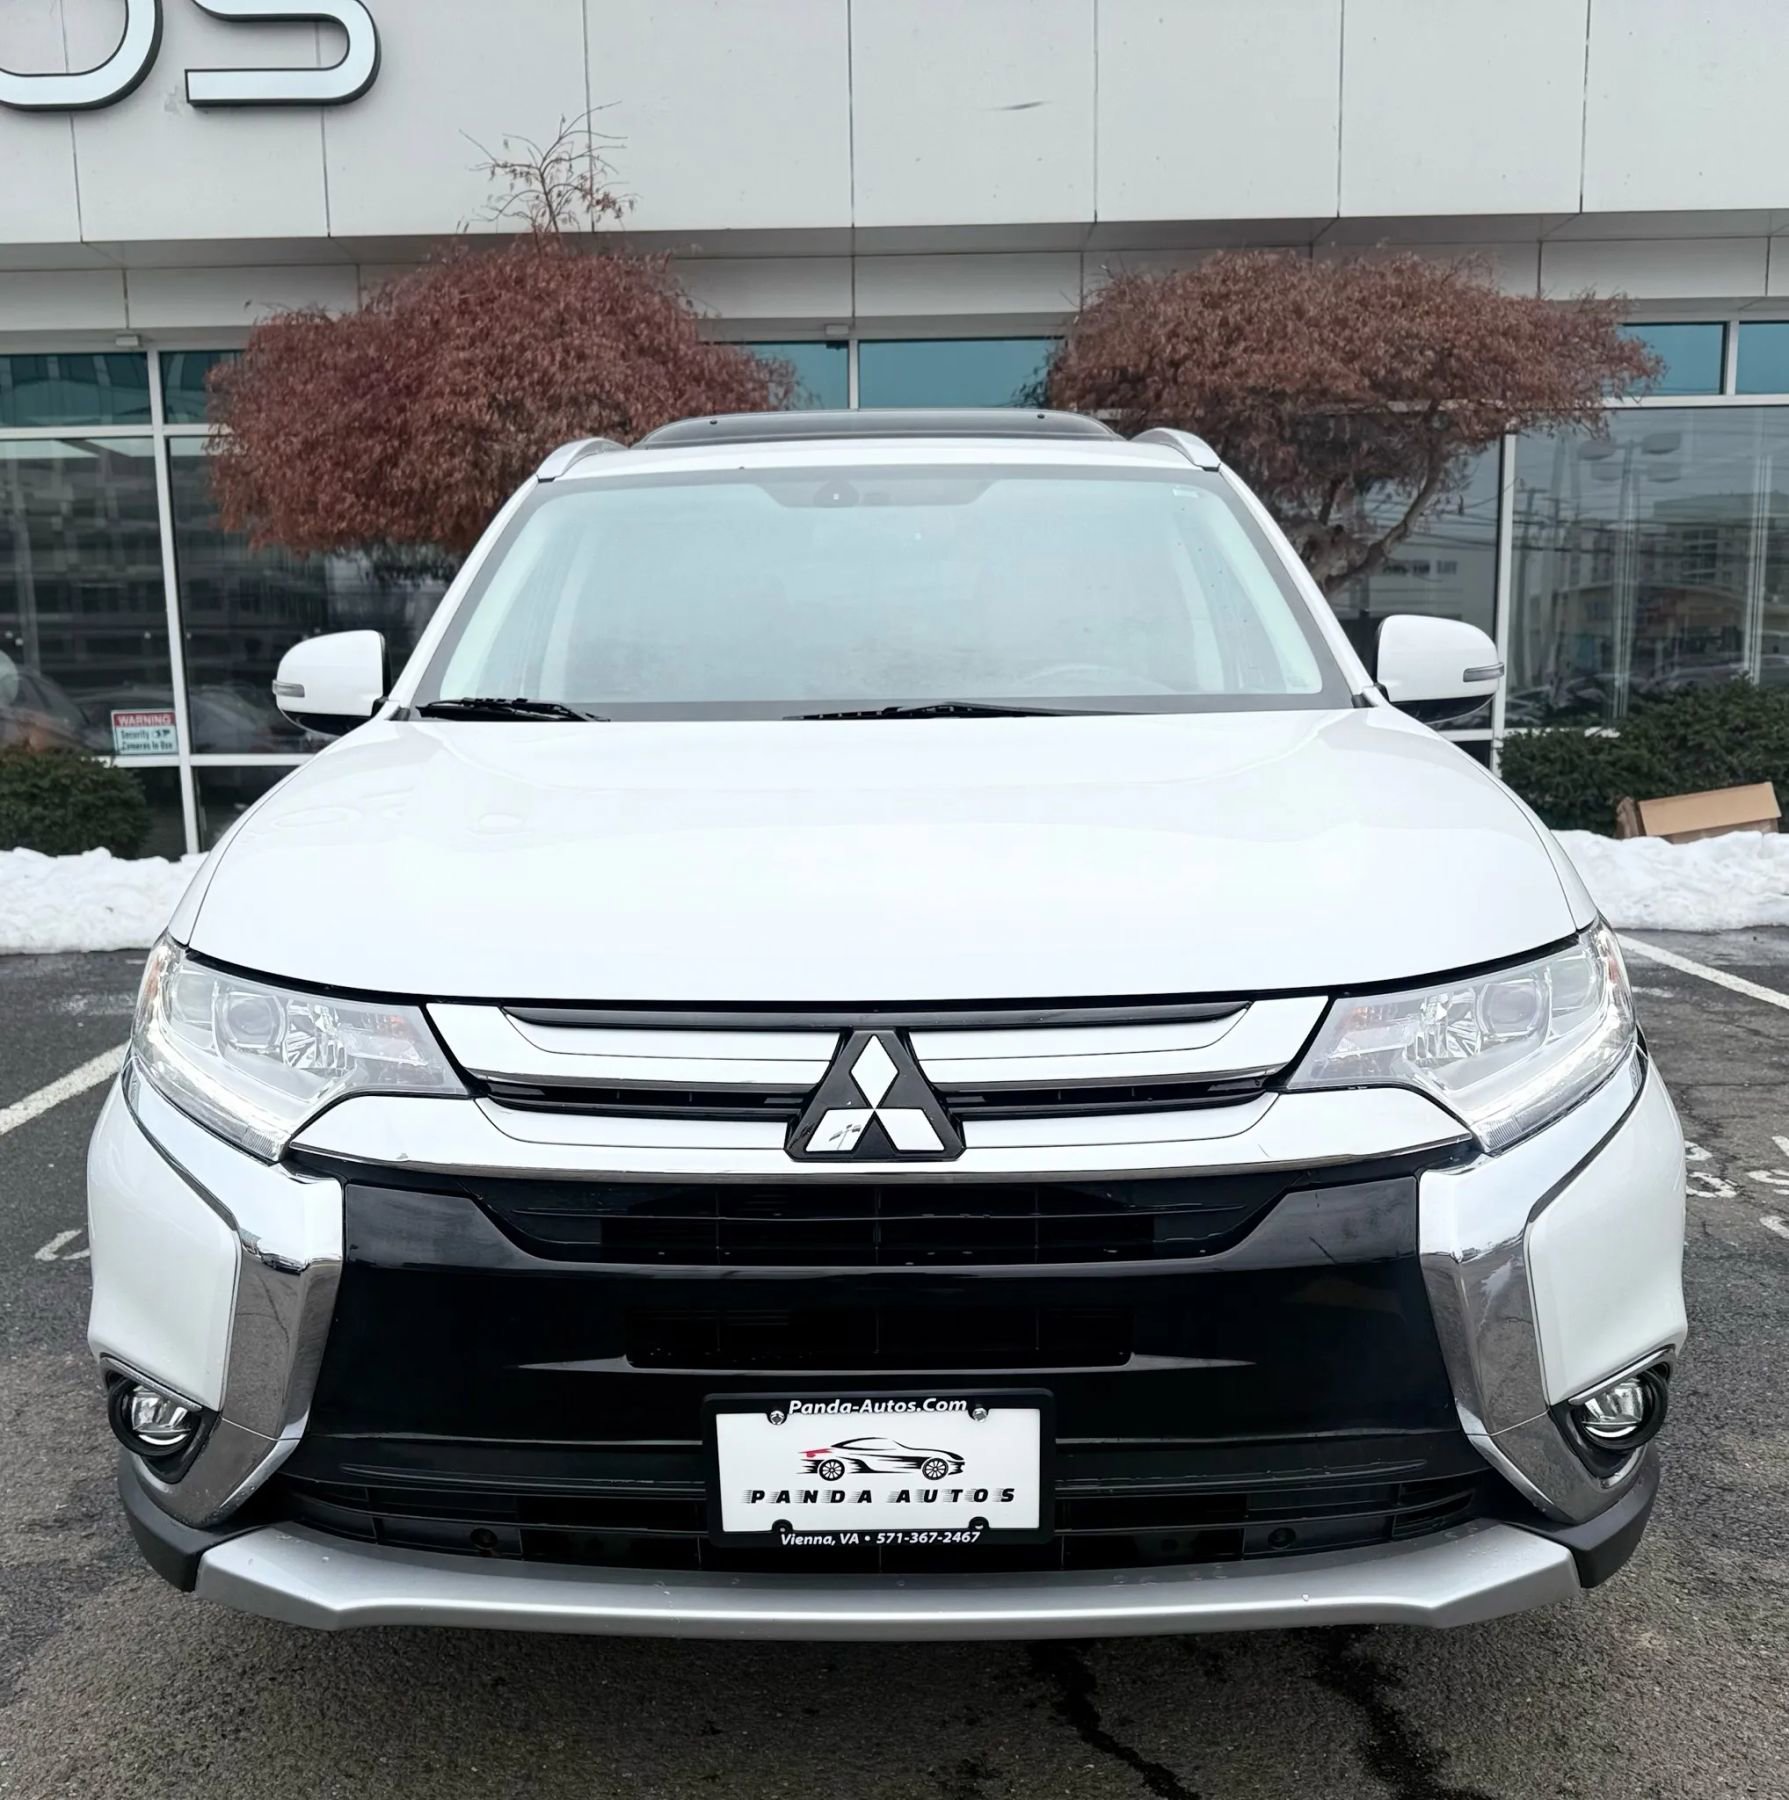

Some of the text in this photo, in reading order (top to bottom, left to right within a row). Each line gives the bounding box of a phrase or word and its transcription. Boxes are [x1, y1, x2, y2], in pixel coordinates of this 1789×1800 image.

[118, 714, 171, 726] WARNING
[788, 1397, 968, 1416] Panda-Autos.Com
[744, 1488, 1016, 1504] PANDA AUTOS
[780, 1532, 981, 1547] Vienna, VA 571-367-2467
